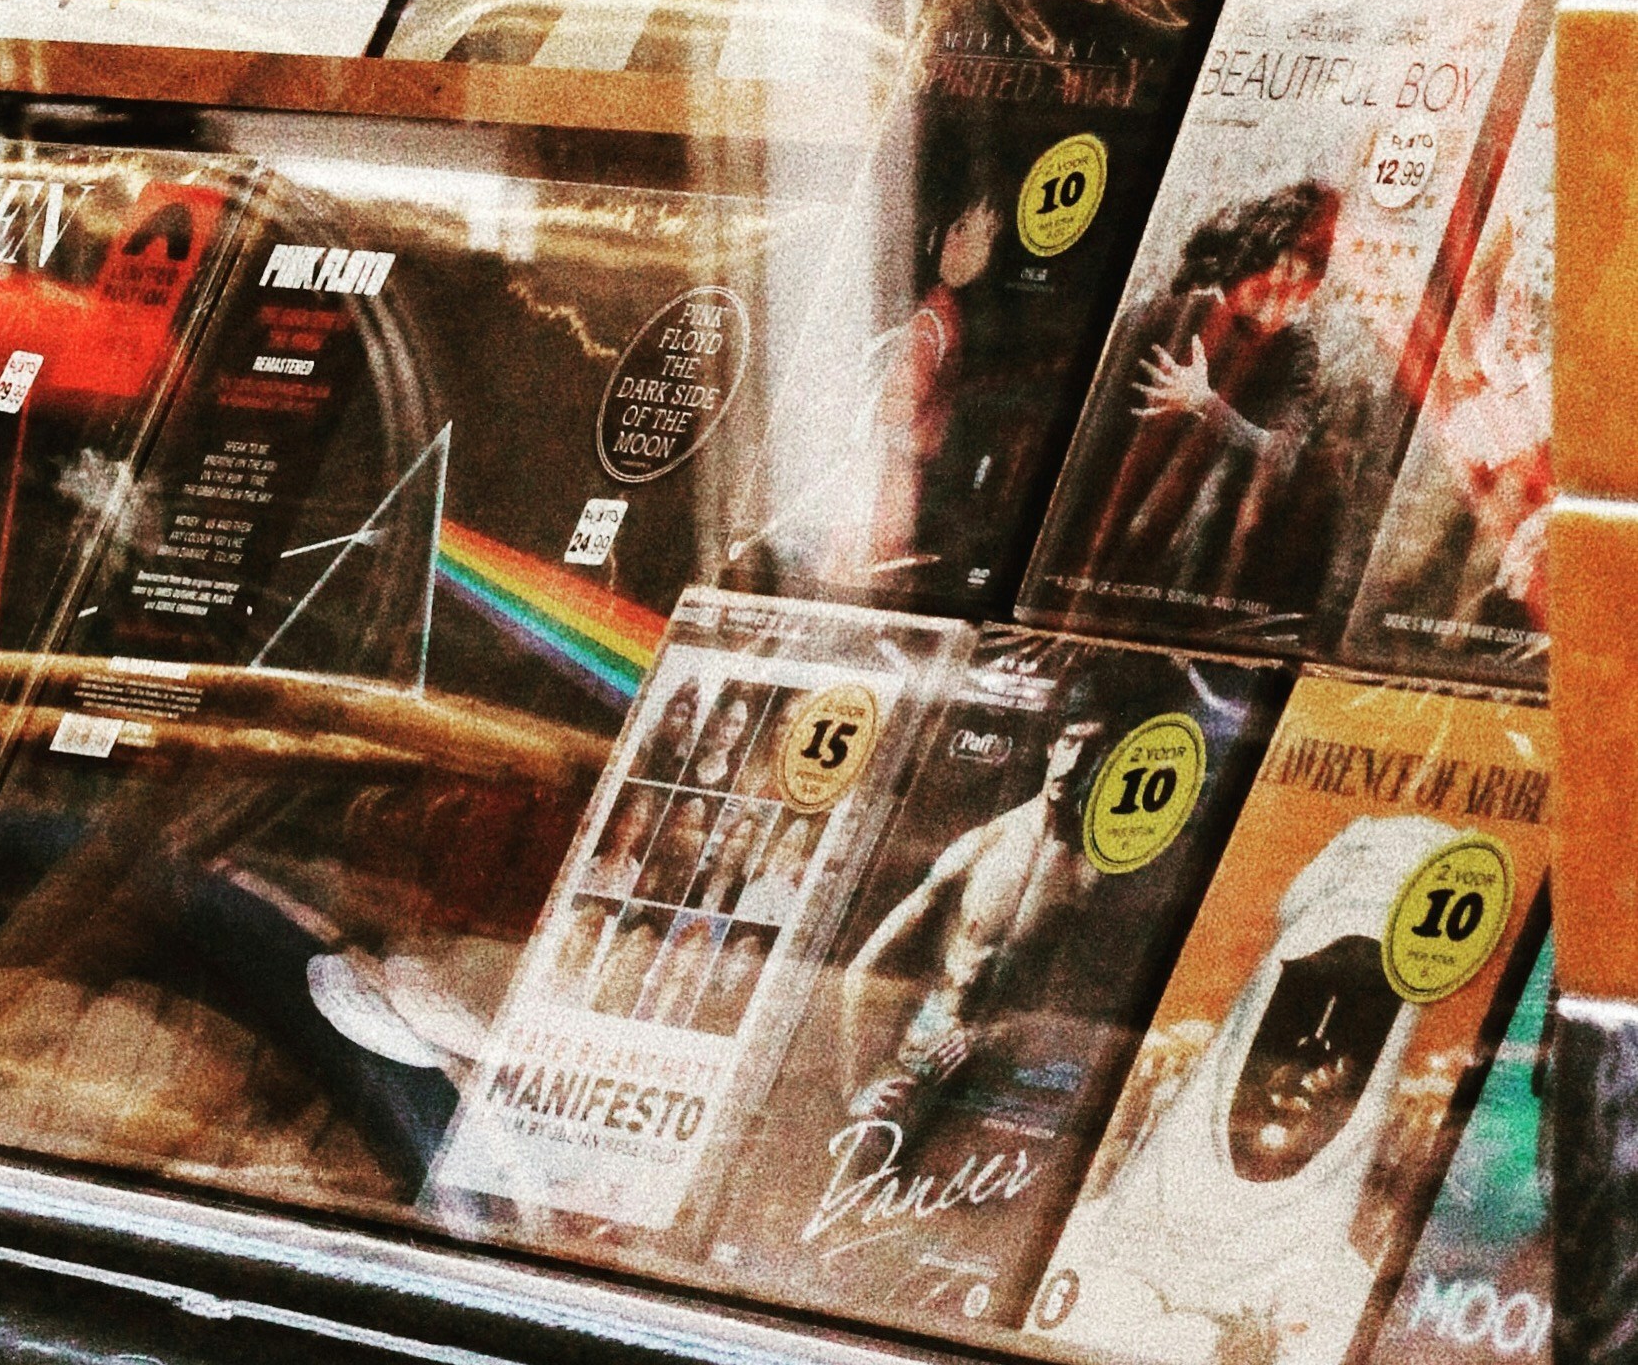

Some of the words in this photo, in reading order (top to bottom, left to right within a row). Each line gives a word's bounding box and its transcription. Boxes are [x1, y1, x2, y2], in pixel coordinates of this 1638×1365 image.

[1200, 49, 1378, 108] BEAUTIFUL
[1395, 61, 1488, 114] BOY
[1375, 158, 1425, 187] 12.99
[1035, 170, 1086, 215] 10
[258, 243, 327, 290] PINK
[313, 246, 397, 296] FLOYD
[678, 302, 729, 328] PINK
[658, 327, 724, 355] FLOYD
[251, 355, 315, 376] REMASTERED
[661, 354, 702, 380] THE
[616, 376, 673, 403] DARK
[670, 383, 721, 411] SIDE
[621, 404, 652, 428] OF
[652, 408, 693, 434] THE
[612, 430, 677, 459] MOON
[569, 532, 612, 555] 24.99
[800, 719, 859, 769] 15
[1129, 747, 1143, 762] 2
[1146, 745, 1187, 761] VOOR
[1109, 767, 1178, 815] 10
[1412, 757, 1469, 811] OF
[1436, 863, 1451, 881] 2
[1455, 870, 1496, 887] VOOR
[1411, 888, 1484, 942] 10
[485, 1060, 708, 1143] MANIFESTO
[799, 1118, 1036, 1245] Dancer
